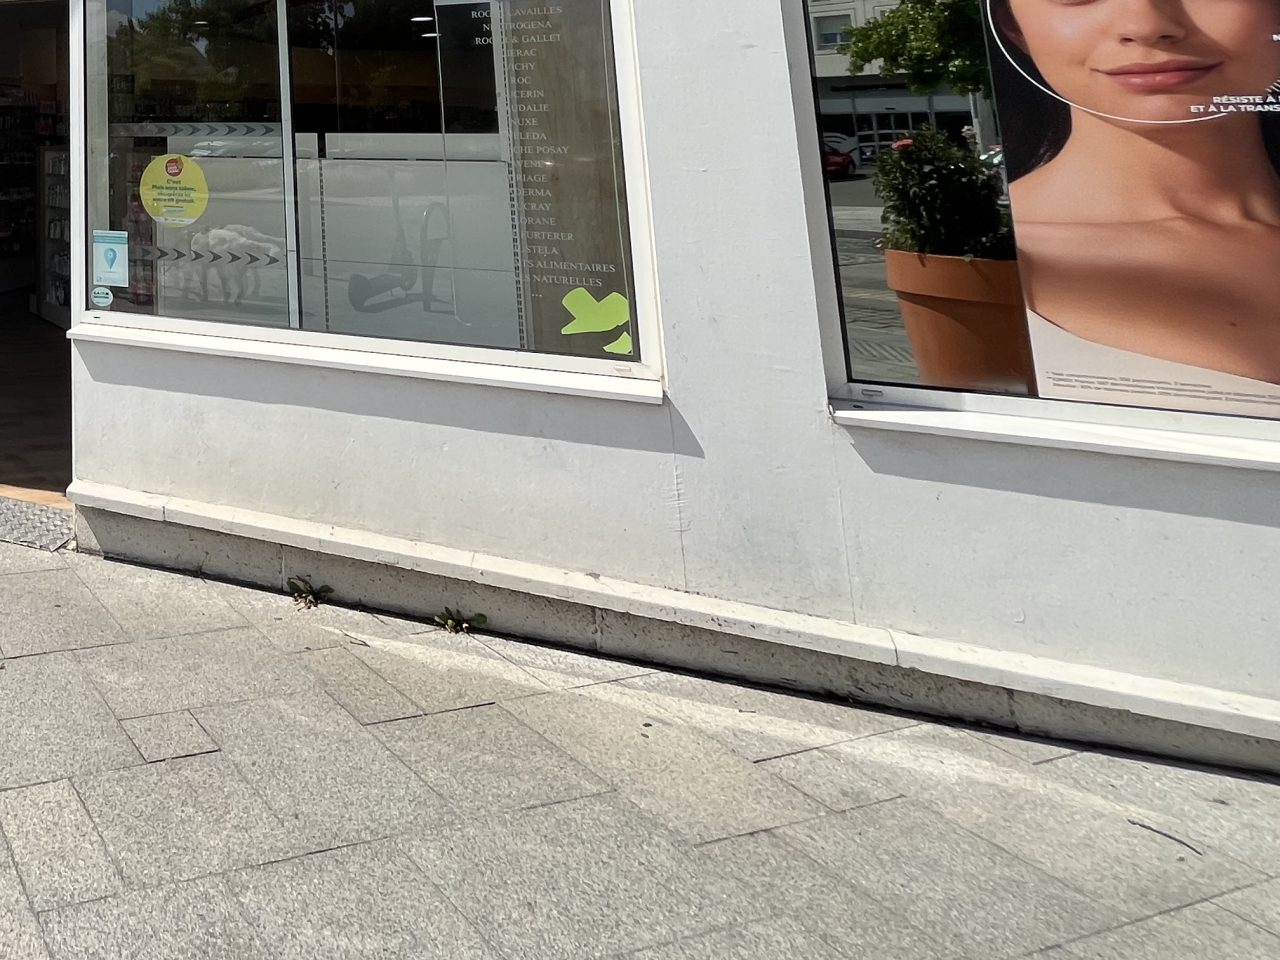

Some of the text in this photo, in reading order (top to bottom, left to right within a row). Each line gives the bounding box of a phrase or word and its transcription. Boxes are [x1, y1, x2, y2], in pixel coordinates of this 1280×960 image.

[1213, 93, 1276, 104] RÉSISTE À
[1190, 105, 1206, 113] ET
[1208, 103, 1218, 113] À
[1220, 104, 1237, 113] LA
[536, 145, 569, 154] POSAY
[535, 261, 616, 273] ALIMENTAIRES
[533, 274, 602, 287] NATURELLES
